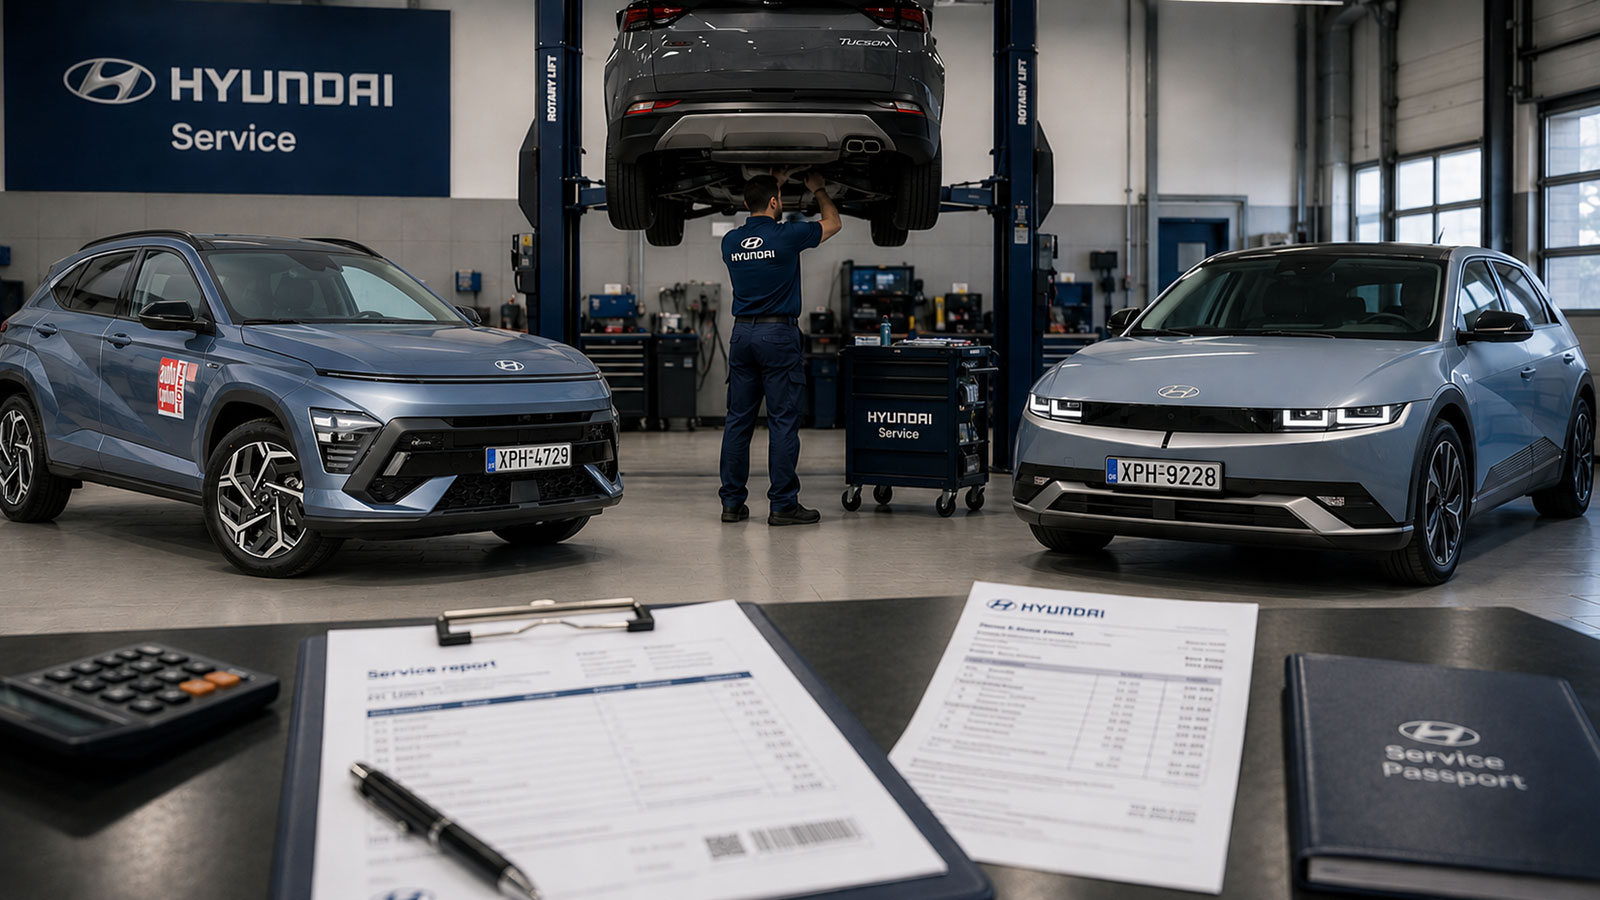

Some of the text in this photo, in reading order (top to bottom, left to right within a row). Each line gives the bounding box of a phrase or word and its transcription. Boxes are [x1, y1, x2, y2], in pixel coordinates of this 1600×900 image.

[839, 38, 890, 47] TUCSON
[171, 67, 393, 107] HYUNDAI
[547, 55, 557, 122] ROTARY LIFT
[1017, 58, 1027, 125] ROTARY LIFT
[171, 122, 296, 152] Service
[731, 250, 775, 261] HYUNDAI
[867, 411, 932, 425] HYUNDAI
[878, 427, 920, 439] Service
[499, 447, 568, 469] XPH-4729
[1121, 462, 1216, 487] XPH-9228
[1020, 602, 1105, 619] HYUNDAI
[367, 659, 498, 680] Service report
[1384, 744, 1505, 771] Service
[1382, 761, 1528, 791] Passport
